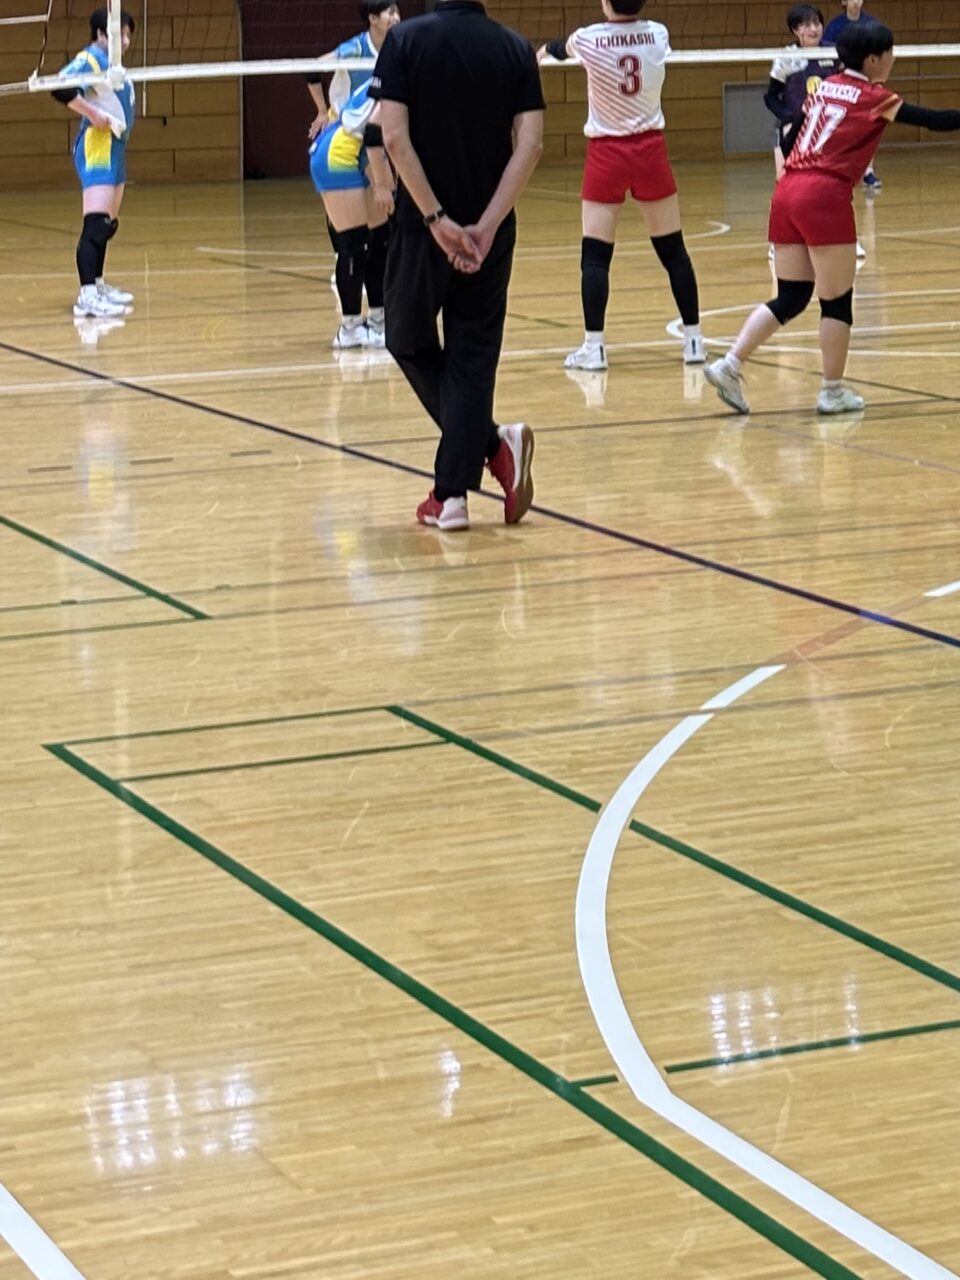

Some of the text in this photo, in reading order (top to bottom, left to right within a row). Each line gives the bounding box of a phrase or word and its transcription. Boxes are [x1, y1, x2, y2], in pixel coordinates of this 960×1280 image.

[595, 32, 656, 49] ICHIKASHI
[616, 55, 643, 97] 3
[799, 101, 848, 154] 17
